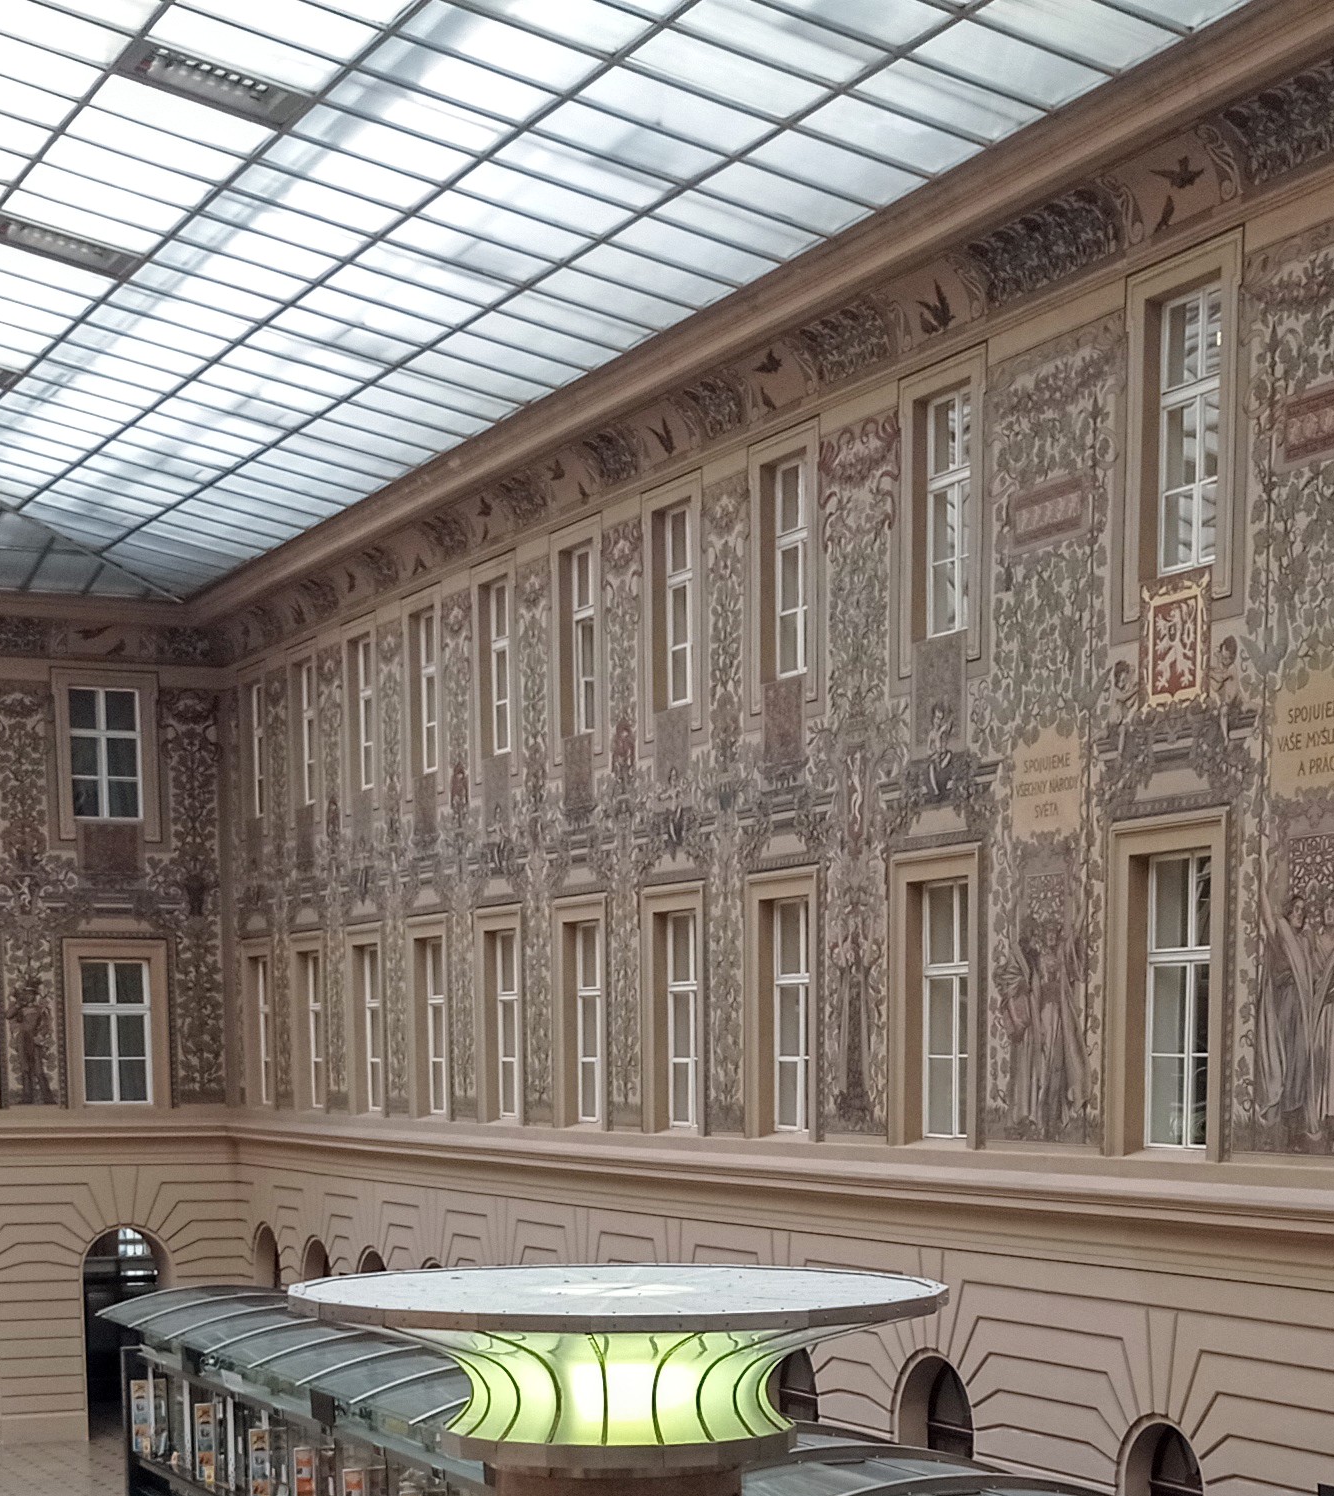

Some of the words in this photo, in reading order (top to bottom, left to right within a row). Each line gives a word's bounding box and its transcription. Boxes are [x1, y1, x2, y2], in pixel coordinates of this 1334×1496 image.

[1277, 732, 1302, 752] VAŠE
[1024, 752, 1070, 773] SPOJUJEME
[1297, 760, 1306, 776] A
[1034, 801, 1059, 819] SVĚTA
